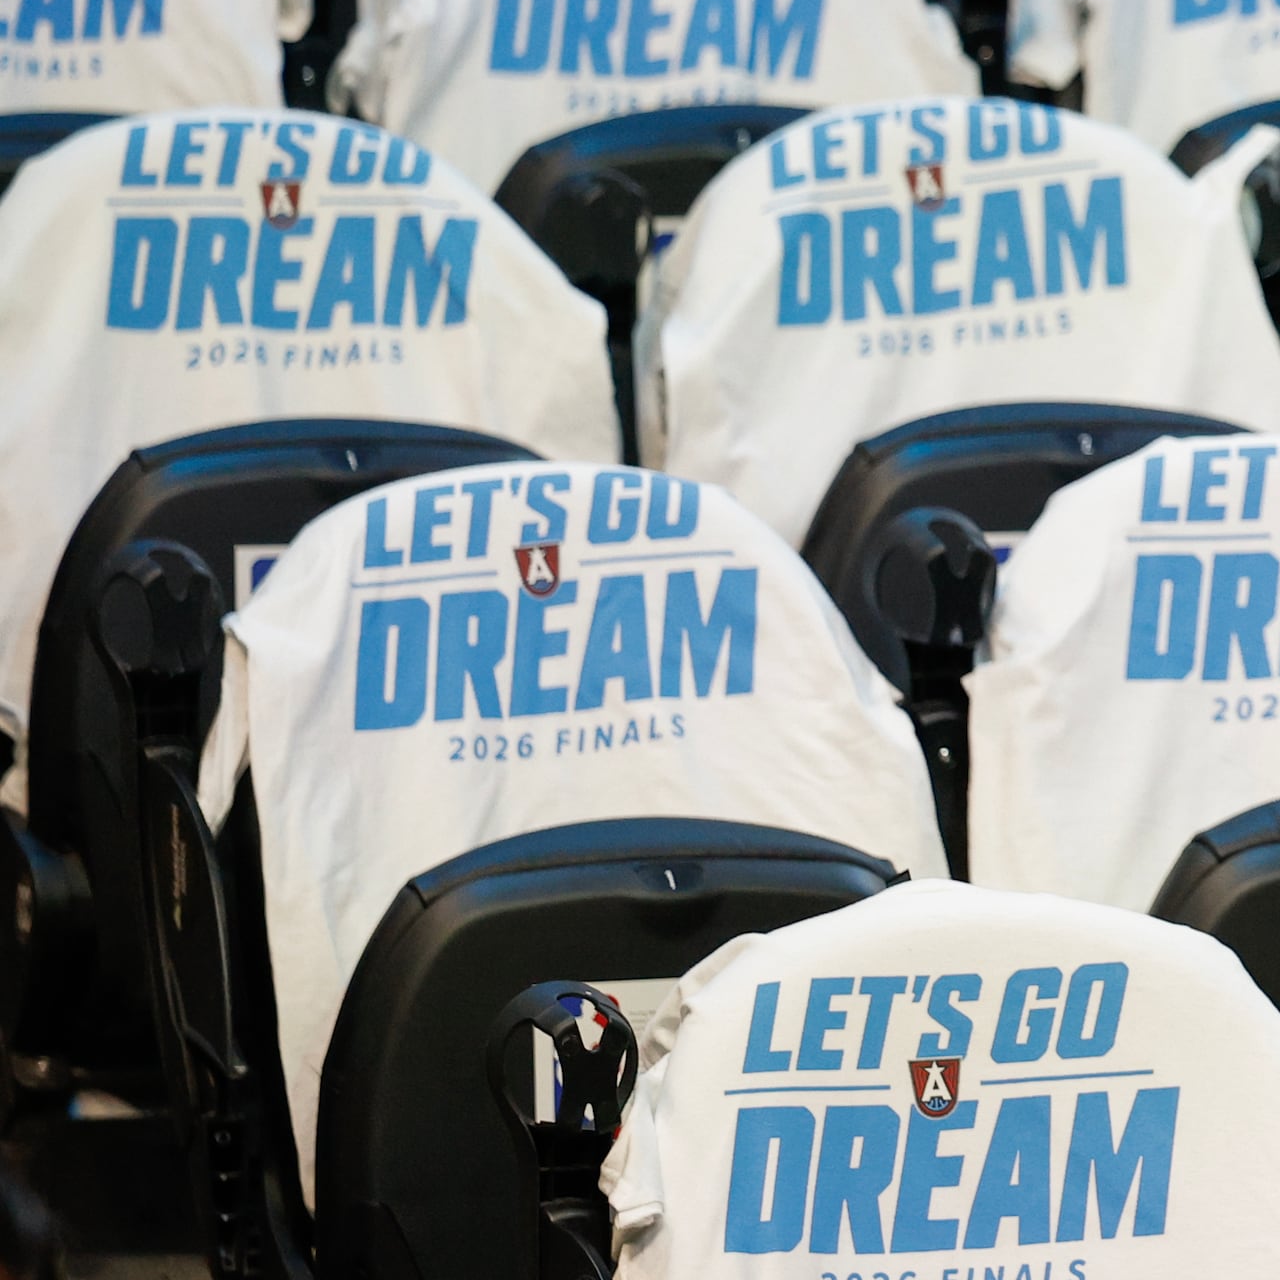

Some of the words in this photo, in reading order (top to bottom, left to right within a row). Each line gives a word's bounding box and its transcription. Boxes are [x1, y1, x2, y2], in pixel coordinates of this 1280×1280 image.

[121, 124, 315, 186] LET'S
[329, 124, 431, 185] GO
[770, 106, 945, 189] LET'S
[968, 97, 1061, 161] GO
[107, 215, 478, 330] DREAM
[778, 177, 1126, 326] DREAM
[364, 474, 570, 568] LET'S
[588, 472, 699, 544] GO
[355, 569, 757, 731] DREAM
[449, 733, 534, 761] 2026
[556, 715, 685, 754] FINALS
[744, 974, 981, 1073] LET'S
[992, 963, 1128, 1063] GO
[725, 1088, 1179, 1254] DREAM
